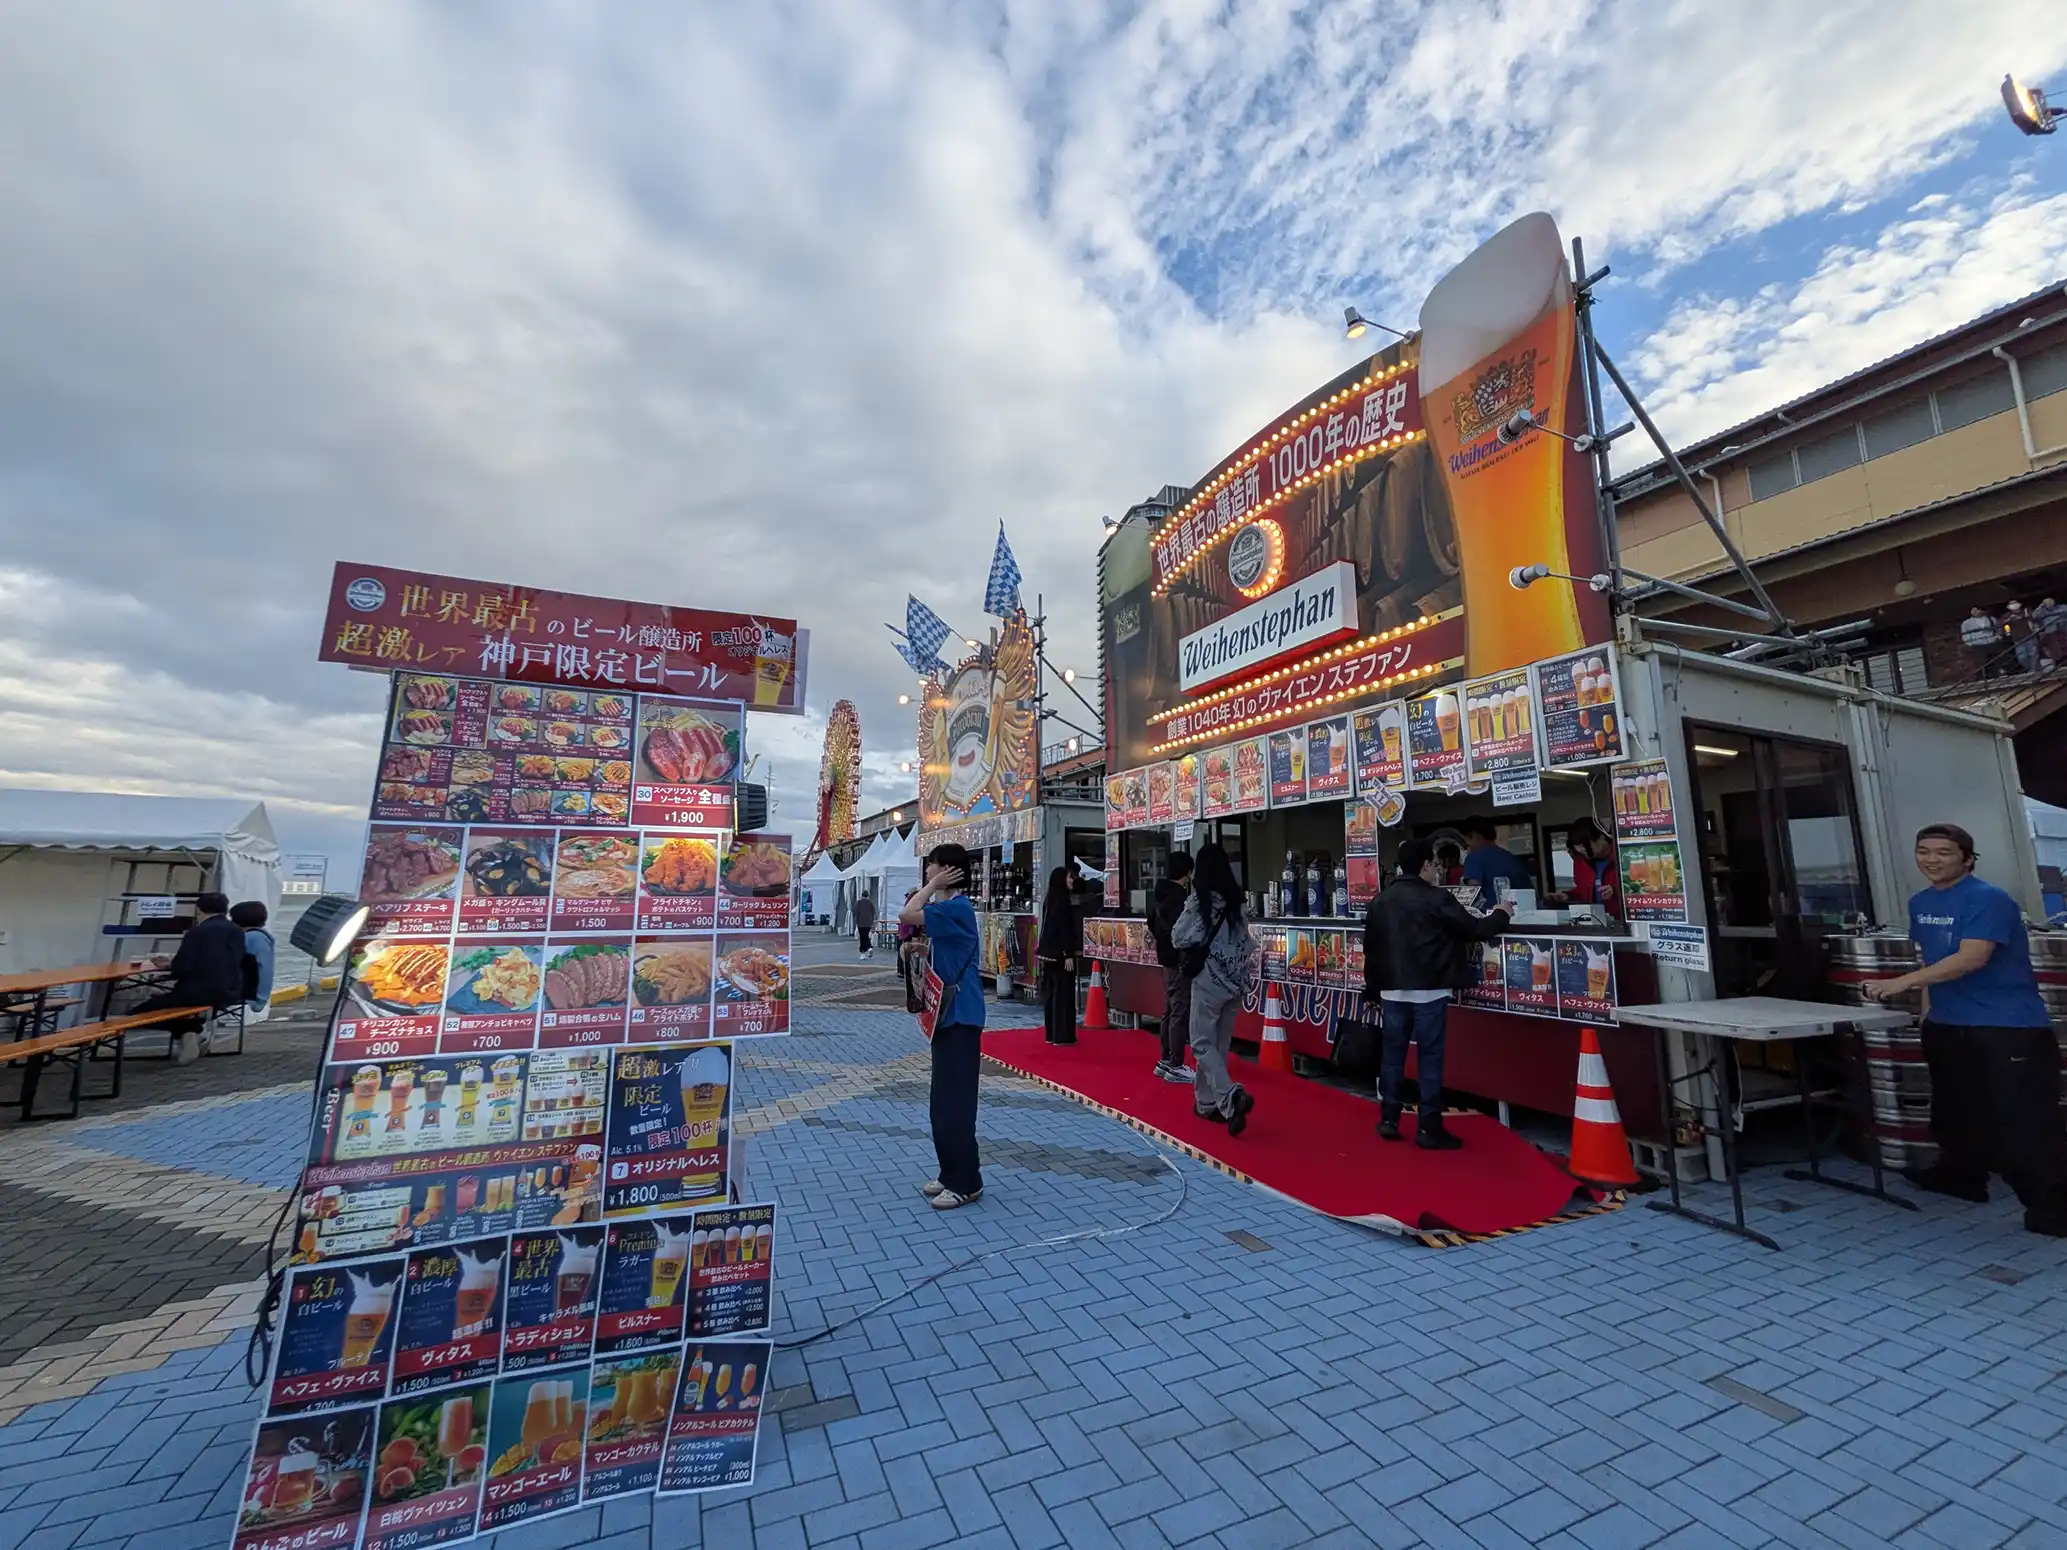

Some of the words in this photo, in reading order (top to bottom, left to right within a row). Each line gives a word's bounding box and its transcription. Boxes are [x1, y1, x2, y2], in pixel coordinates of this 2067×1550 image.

[1448, 407, 1550, 474] Weihenan
[1157, 463, 1260, 577] 世界最古の醸造所
[1269, 379, 1406, 492] 1000年の歴史
[398, 584, 703, 653] 世界最古のビール醸造所
[1184, 586, 1336, 678] Weihenstephan
[333, 620, 467, 665] 超激レア
[478, 634, 729, 692] 神戸限定ビール
[1410, 702, 1430, 719] 幻の
[1409, 720, 1435, 731] 白ビール
[1419, 752, 1463, 766] ヘフェ・ヴァイス
[1484, 757, 1509, 769] ¥2,800
[1367, 763, 1402, 775] オリジナルヘレス
[1318, 776, 1339, 786] ヴィタス
[636, 790, 651, 798] 30
[653, 787, 698, 796] スペアリブ入り
[1497, 793, 1513, 802] Beer
[1514, 791, 1538, 800] Cashier
[660, 795, 695, 804] ソーセージ
[665, 811, 704, 824] ¥1,900
[1629, 828, 1653, 836] ¥2,800
[732, 901, 759, 909] ガーリック
[1627, 897, 1683, 905] プライムワインカクテル
[414, 904, 448, 912] ステーキ
[576, 918, 606, 928] ¥1,500
[692, 917, 713, 926] ¥900
[720, 917, 741, 926] ¥700
[1654, 953, 1683, 964] Return
[1684, 957, 1705, 966] glass
[1518, 993, 1544, 1002] ヴィタス
[717, 1007, 728, 1015] 53
[1564, 999, 1612, 1011] ヘフェ・ヴァイス
[544, 1014, 555, 1024] 51
[632, 1011, 645, 1021] 46
[369, 1025, 433, 1037] チーズナチョス
[656, 1027, 680, 1038] ¥800
[739, 1021, 763, 1032] ¥700
[473, 1036, 501, 1048] ¥700
[569, 1031, 601, 1042] ¥1,000
[365, 1041, 400, 1055] ¥900
[623, 1084, 663, 1107] 限定
[640, 1103, 672, 1116] ビール
[648, 1120, 713, 1150] 限定100杯
[632, 1154, 720, 1175] オリジナルヘレス
[609, 1185, 659, 1206] ¥1,800
[526, 1239, 559, 1260] 世界
[422, 1257, 458, 1278] 濃厚
[619, 1255, 650, 1268] ラガー
[514, 1257, 552, 1280] 最古
[711, 1271, 750, 1283] 飲み比べセット
[308, 1276, 344, 1300] 幻の
[410, 1278, 453, 1296] 白ビール
[509, 1282, 552, 1298] 黒ビール
[297, 1301, 345, 1317] 白ビール
[618, 1314, 662, 1329] ピルスナー
[505, 1326, 586, 1349] トラディション
[422, 1344, 473, 1366] ヴィタス
[282, 1370, 381, 1396] ヘフェ・ヴァイス
[396, 1377, 430, 1394] ¥1,500
[673, 1419, 717, 1430] ノンアルコール
[717, 1418, 755, 1429] ビアカクテル
[594, 1442, 660, 1464] マンゴーカクテル
[724, 1470, 750, 1481] ¥1,000
[487, 1466, 572, 1500] マンゴーエール
[380, 1497, 468, 1527] 白桃ヴァイツェン
[494, 1502, 527, 1520] ¥1,500
